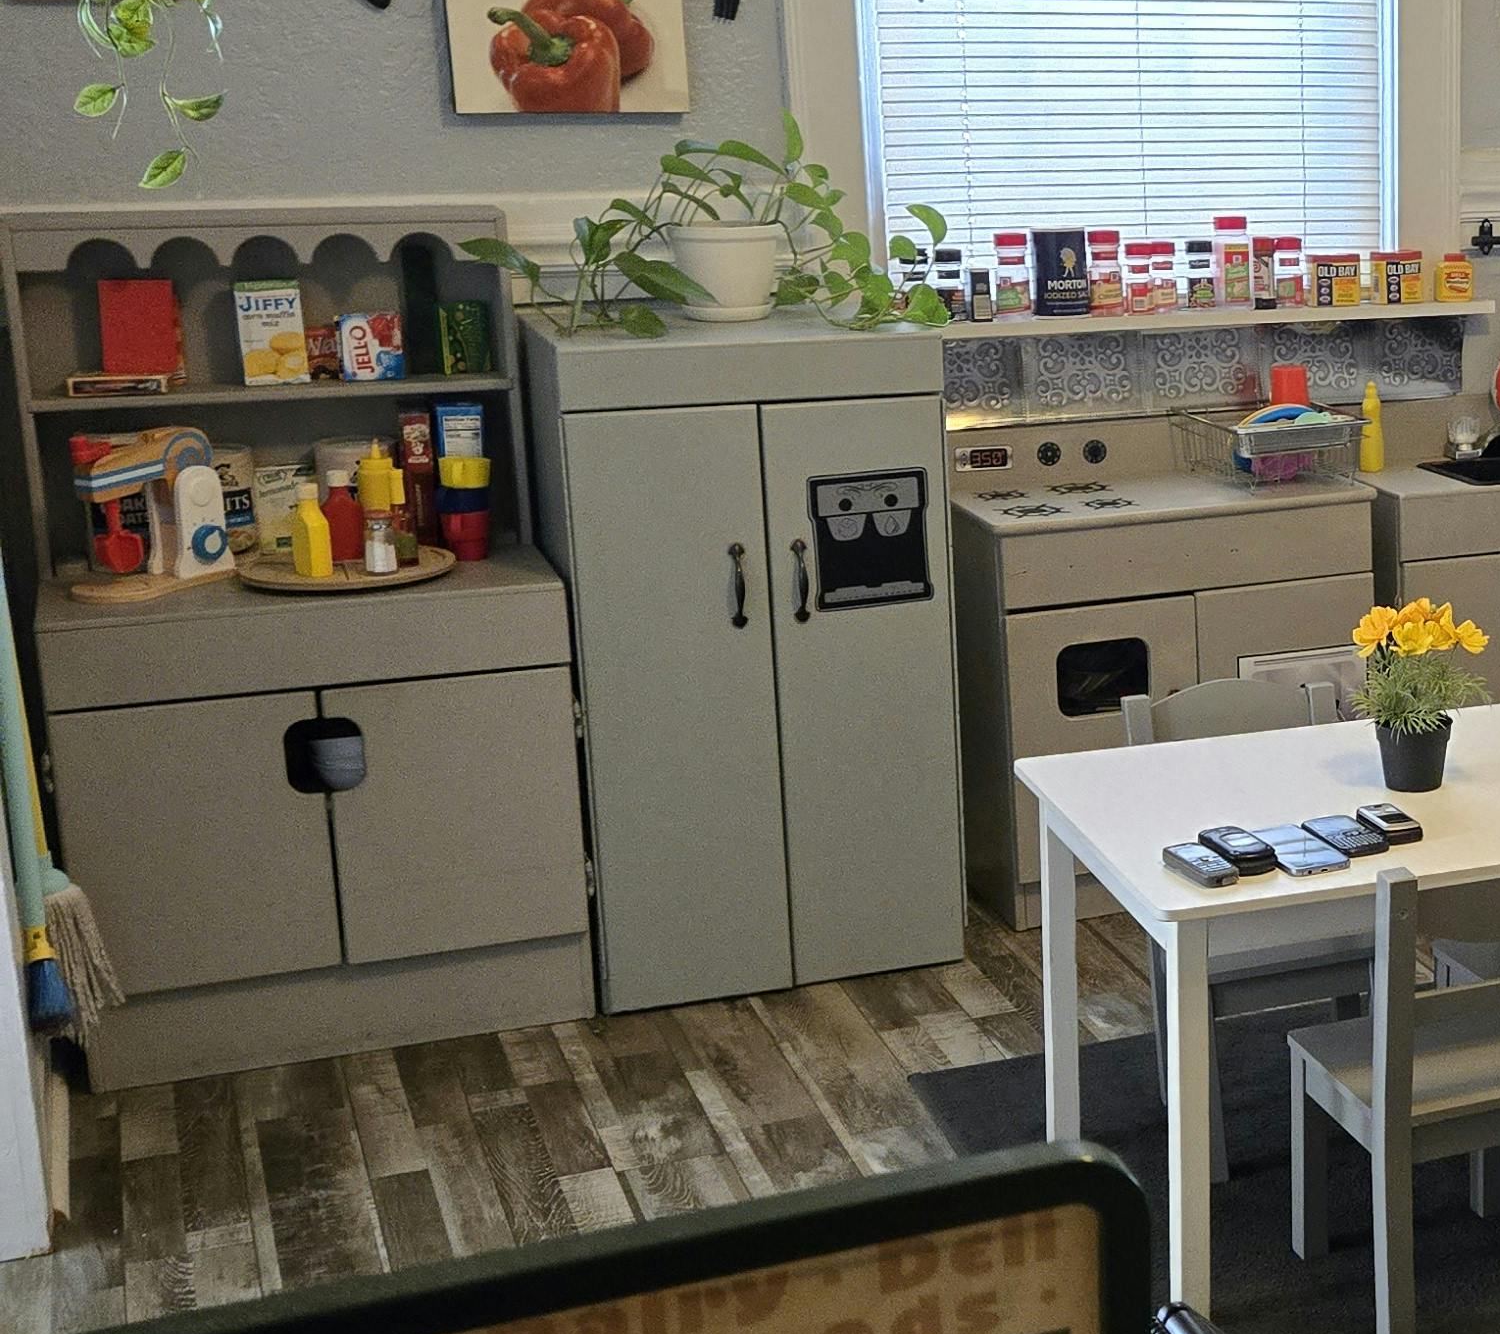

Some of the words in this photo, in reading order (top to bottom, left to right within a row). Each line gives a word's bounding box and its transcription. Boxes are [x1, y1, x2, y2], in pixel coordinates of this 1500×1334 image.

[1317, 265, 1337, 277] OLD
[1338, 264, 1356, 277] BAY
[1387, 263, 1404, 275] OLD
[1404, 262, 1421, 274] BAY
[1047, 278, 1087, 290] MORTON
[239, 295, 297, 313] JIFFY
[876, 1216, 1060, 1295] Deli
